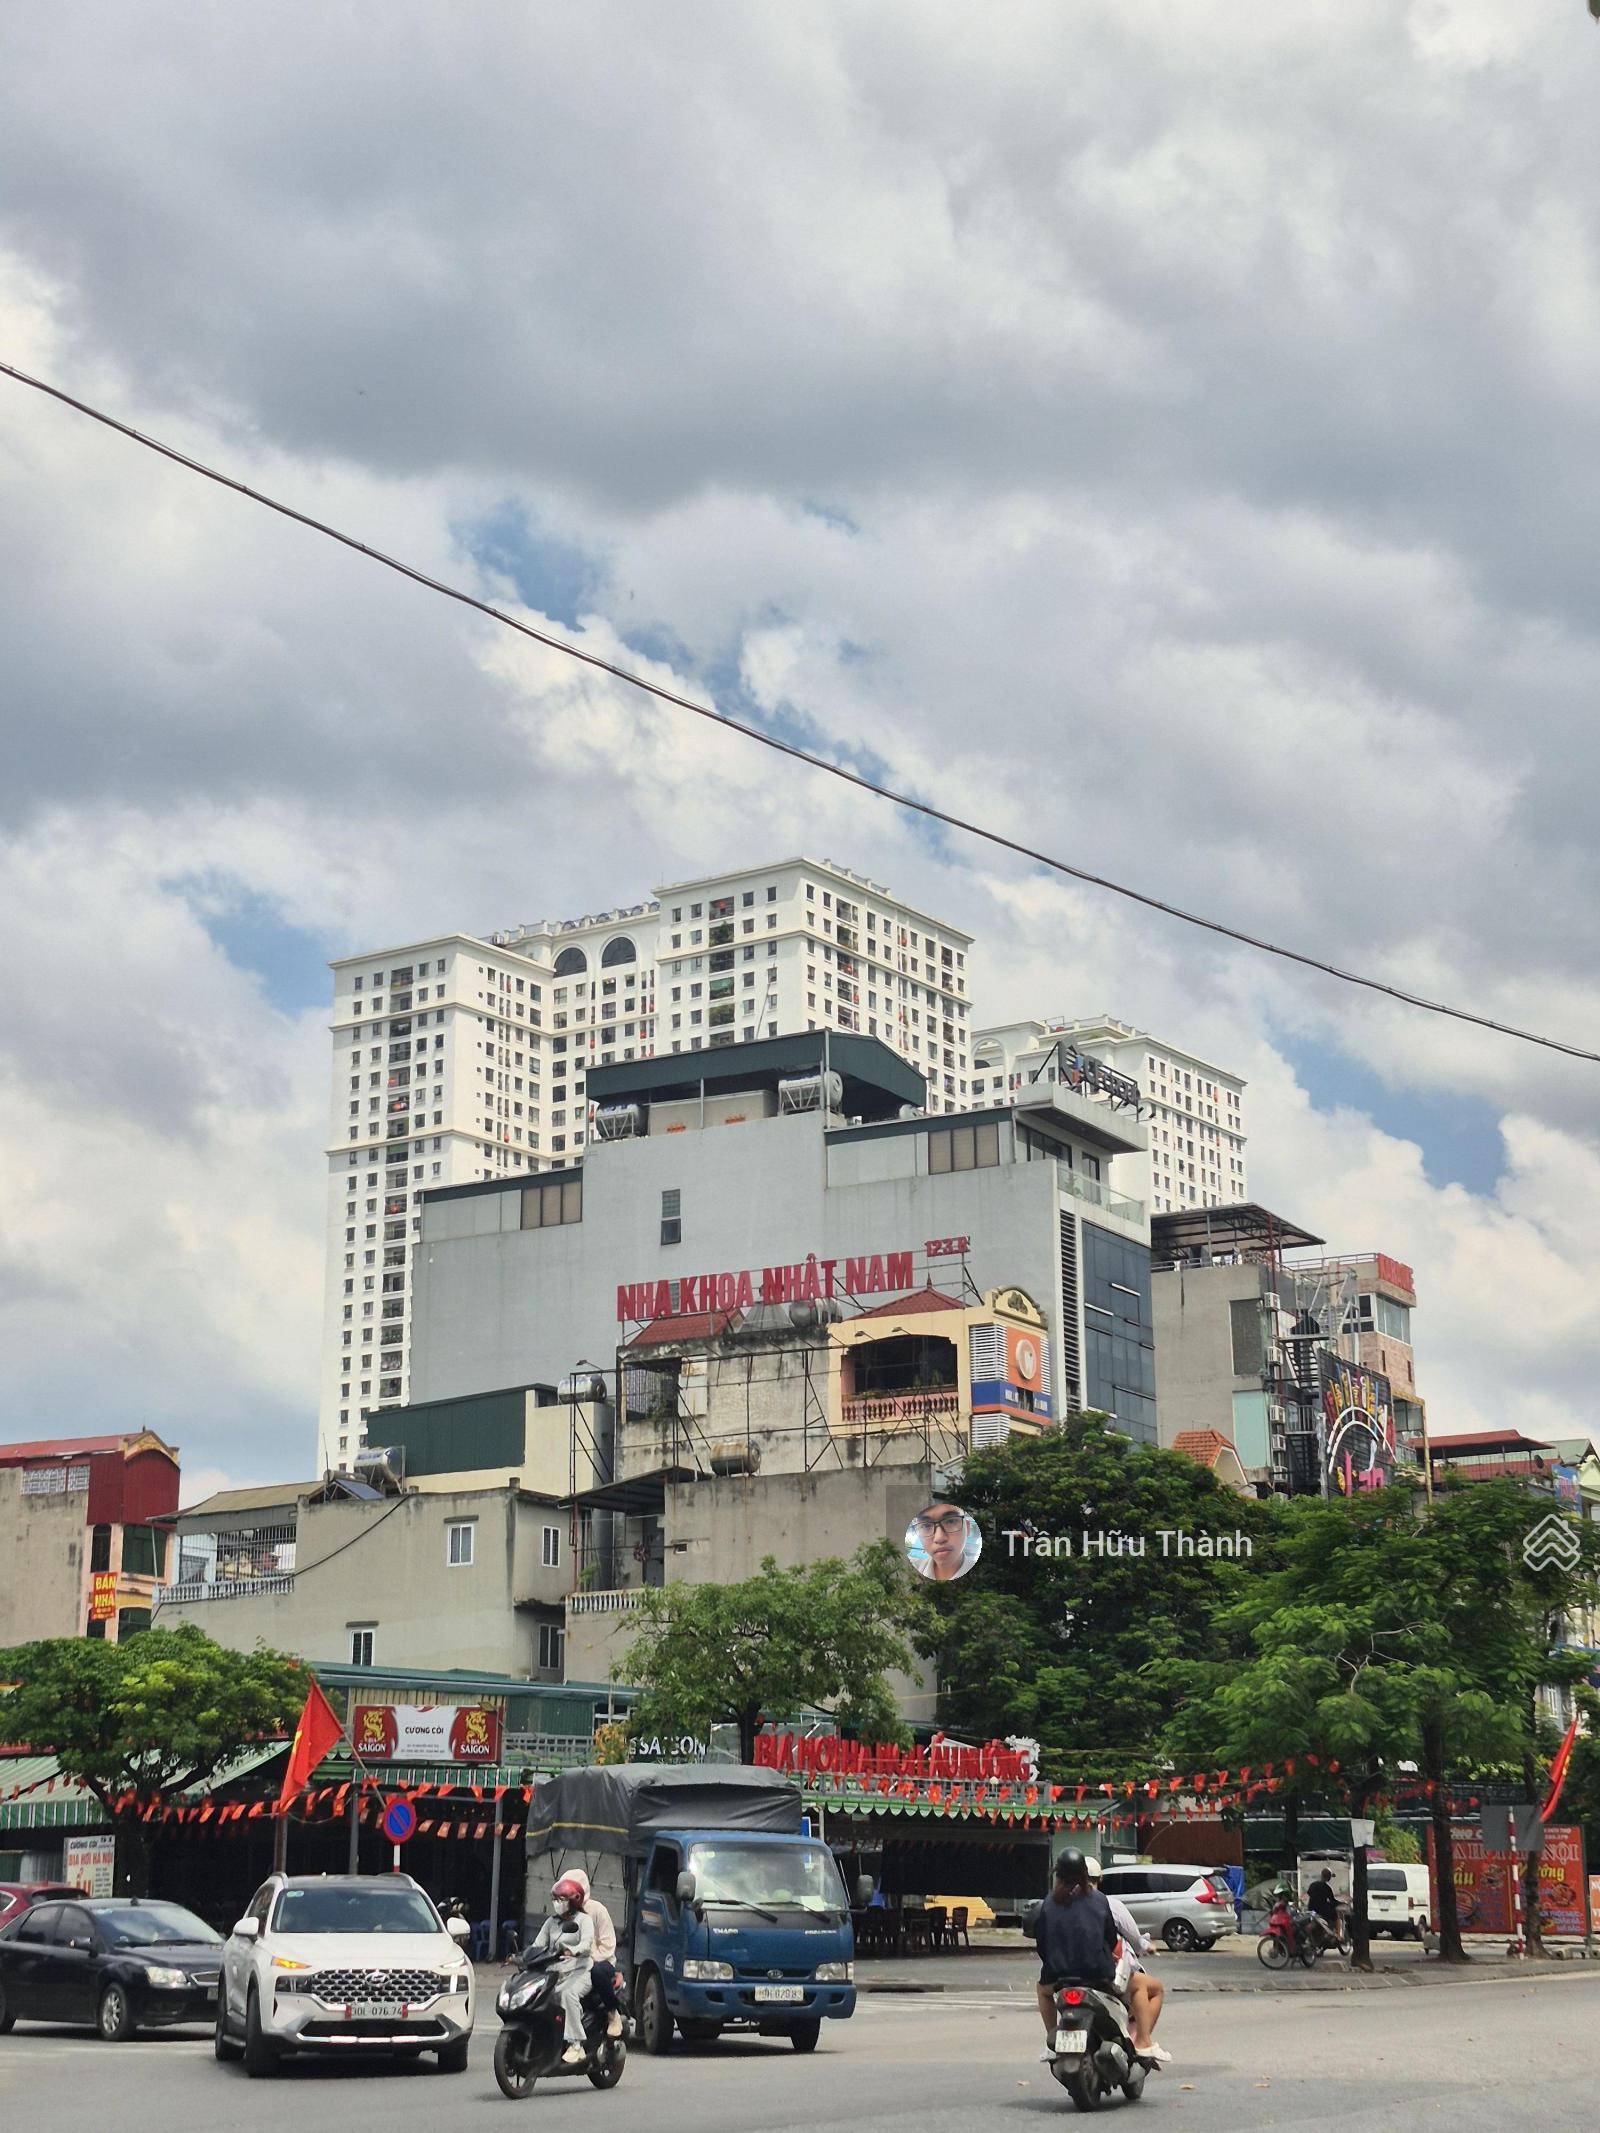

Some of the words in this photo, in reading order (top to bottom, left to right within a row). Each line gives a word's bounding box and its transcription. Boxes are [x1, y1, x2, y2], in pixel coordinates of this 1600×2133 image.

[617, 1280, 673, 1321] NHA
[680, 1270, 755, 1314] KHOA
[763, 1253, 838, 1309] NHẬT
[846, 1251, 913, 1296] NAM
[95, 1573, 117, 1590] BÁN
[358, 1743, 386, 1753] SAIGON
[460, 1745, 490, 1755] SAIGON
